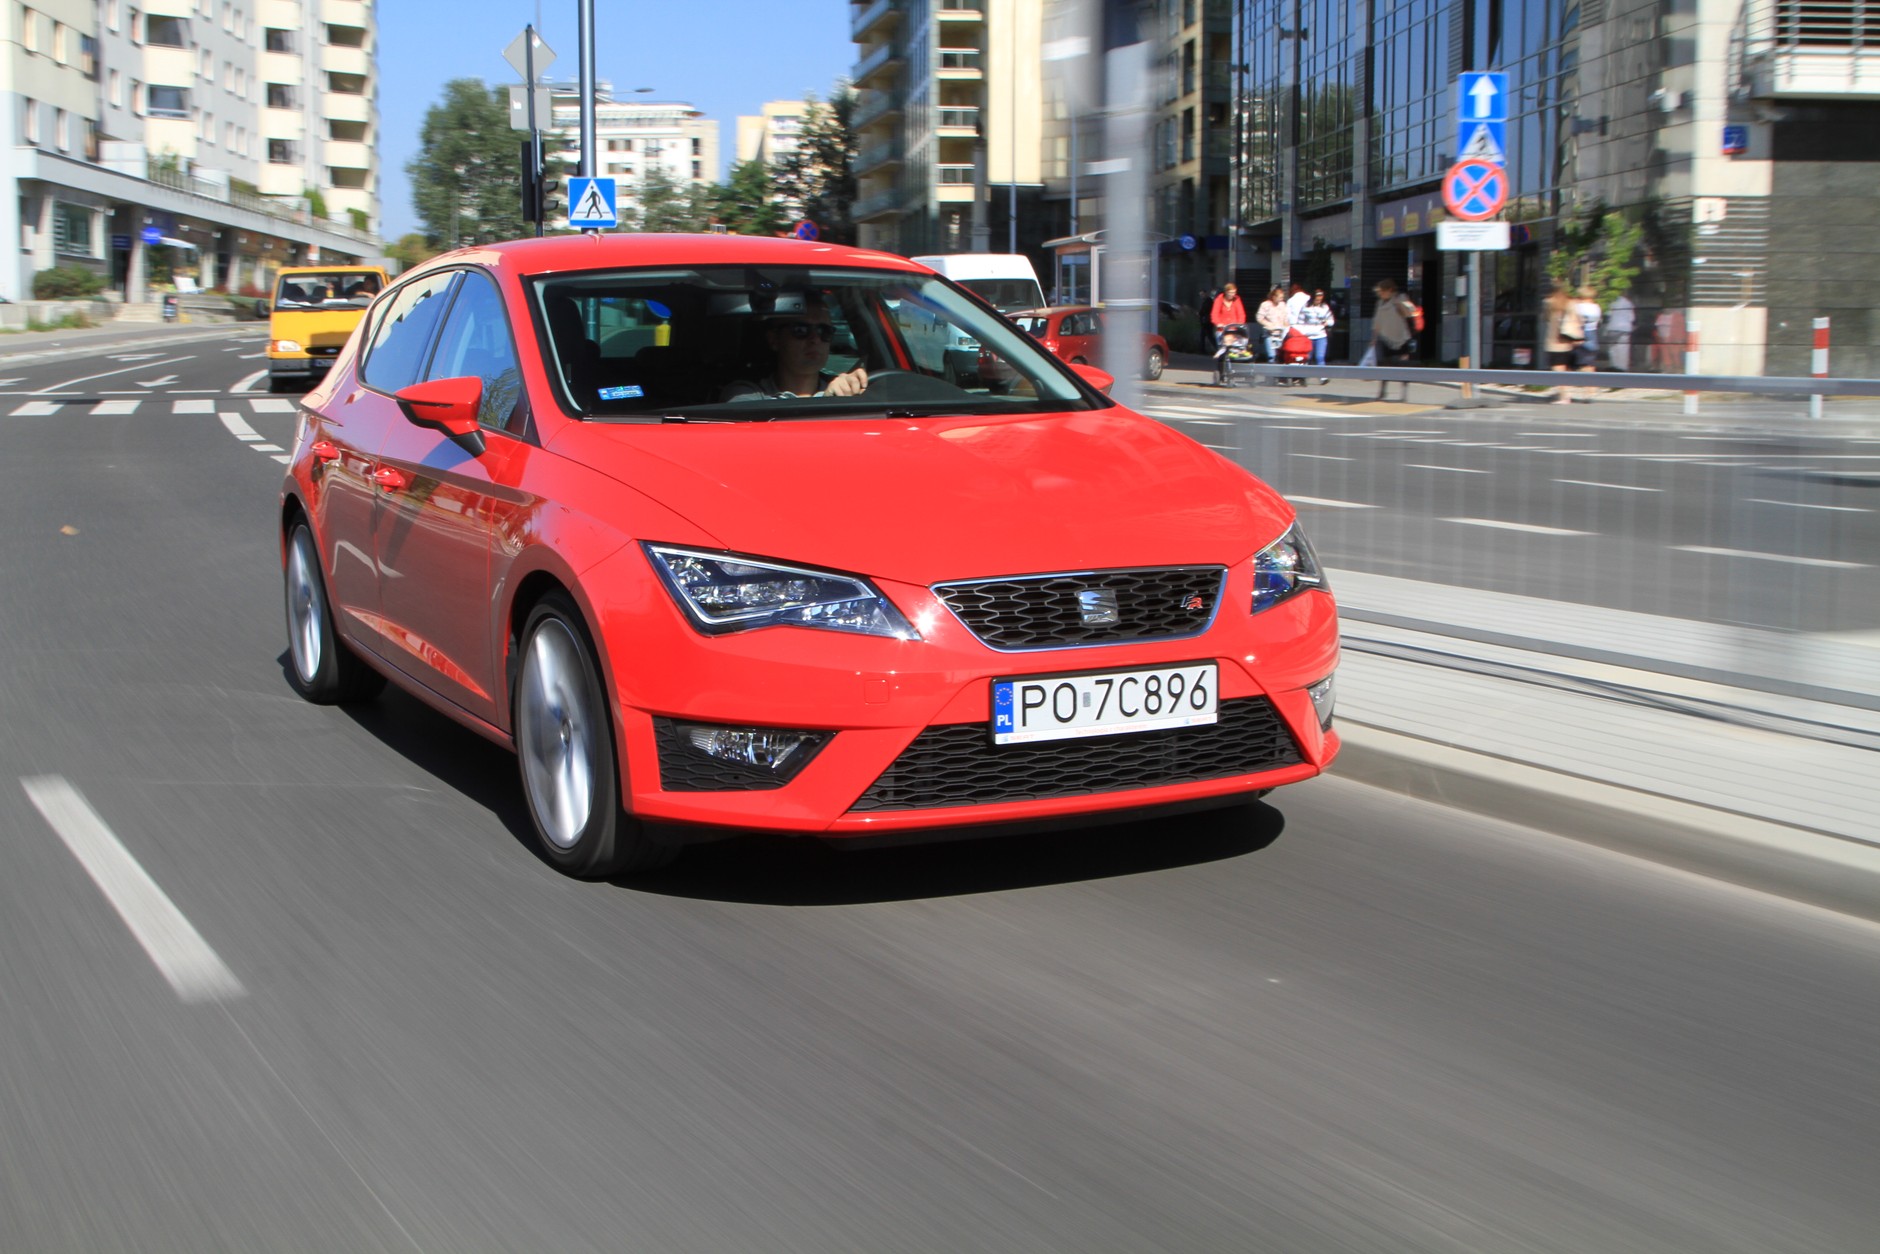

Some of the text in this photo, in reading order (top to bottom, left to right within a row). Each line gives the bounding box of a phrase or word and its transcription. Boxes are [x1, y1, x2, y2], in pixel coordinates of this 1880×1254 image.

[1021, 669, 1208, 727] PO 7C896
[997, 714, 1012, 727] PL
